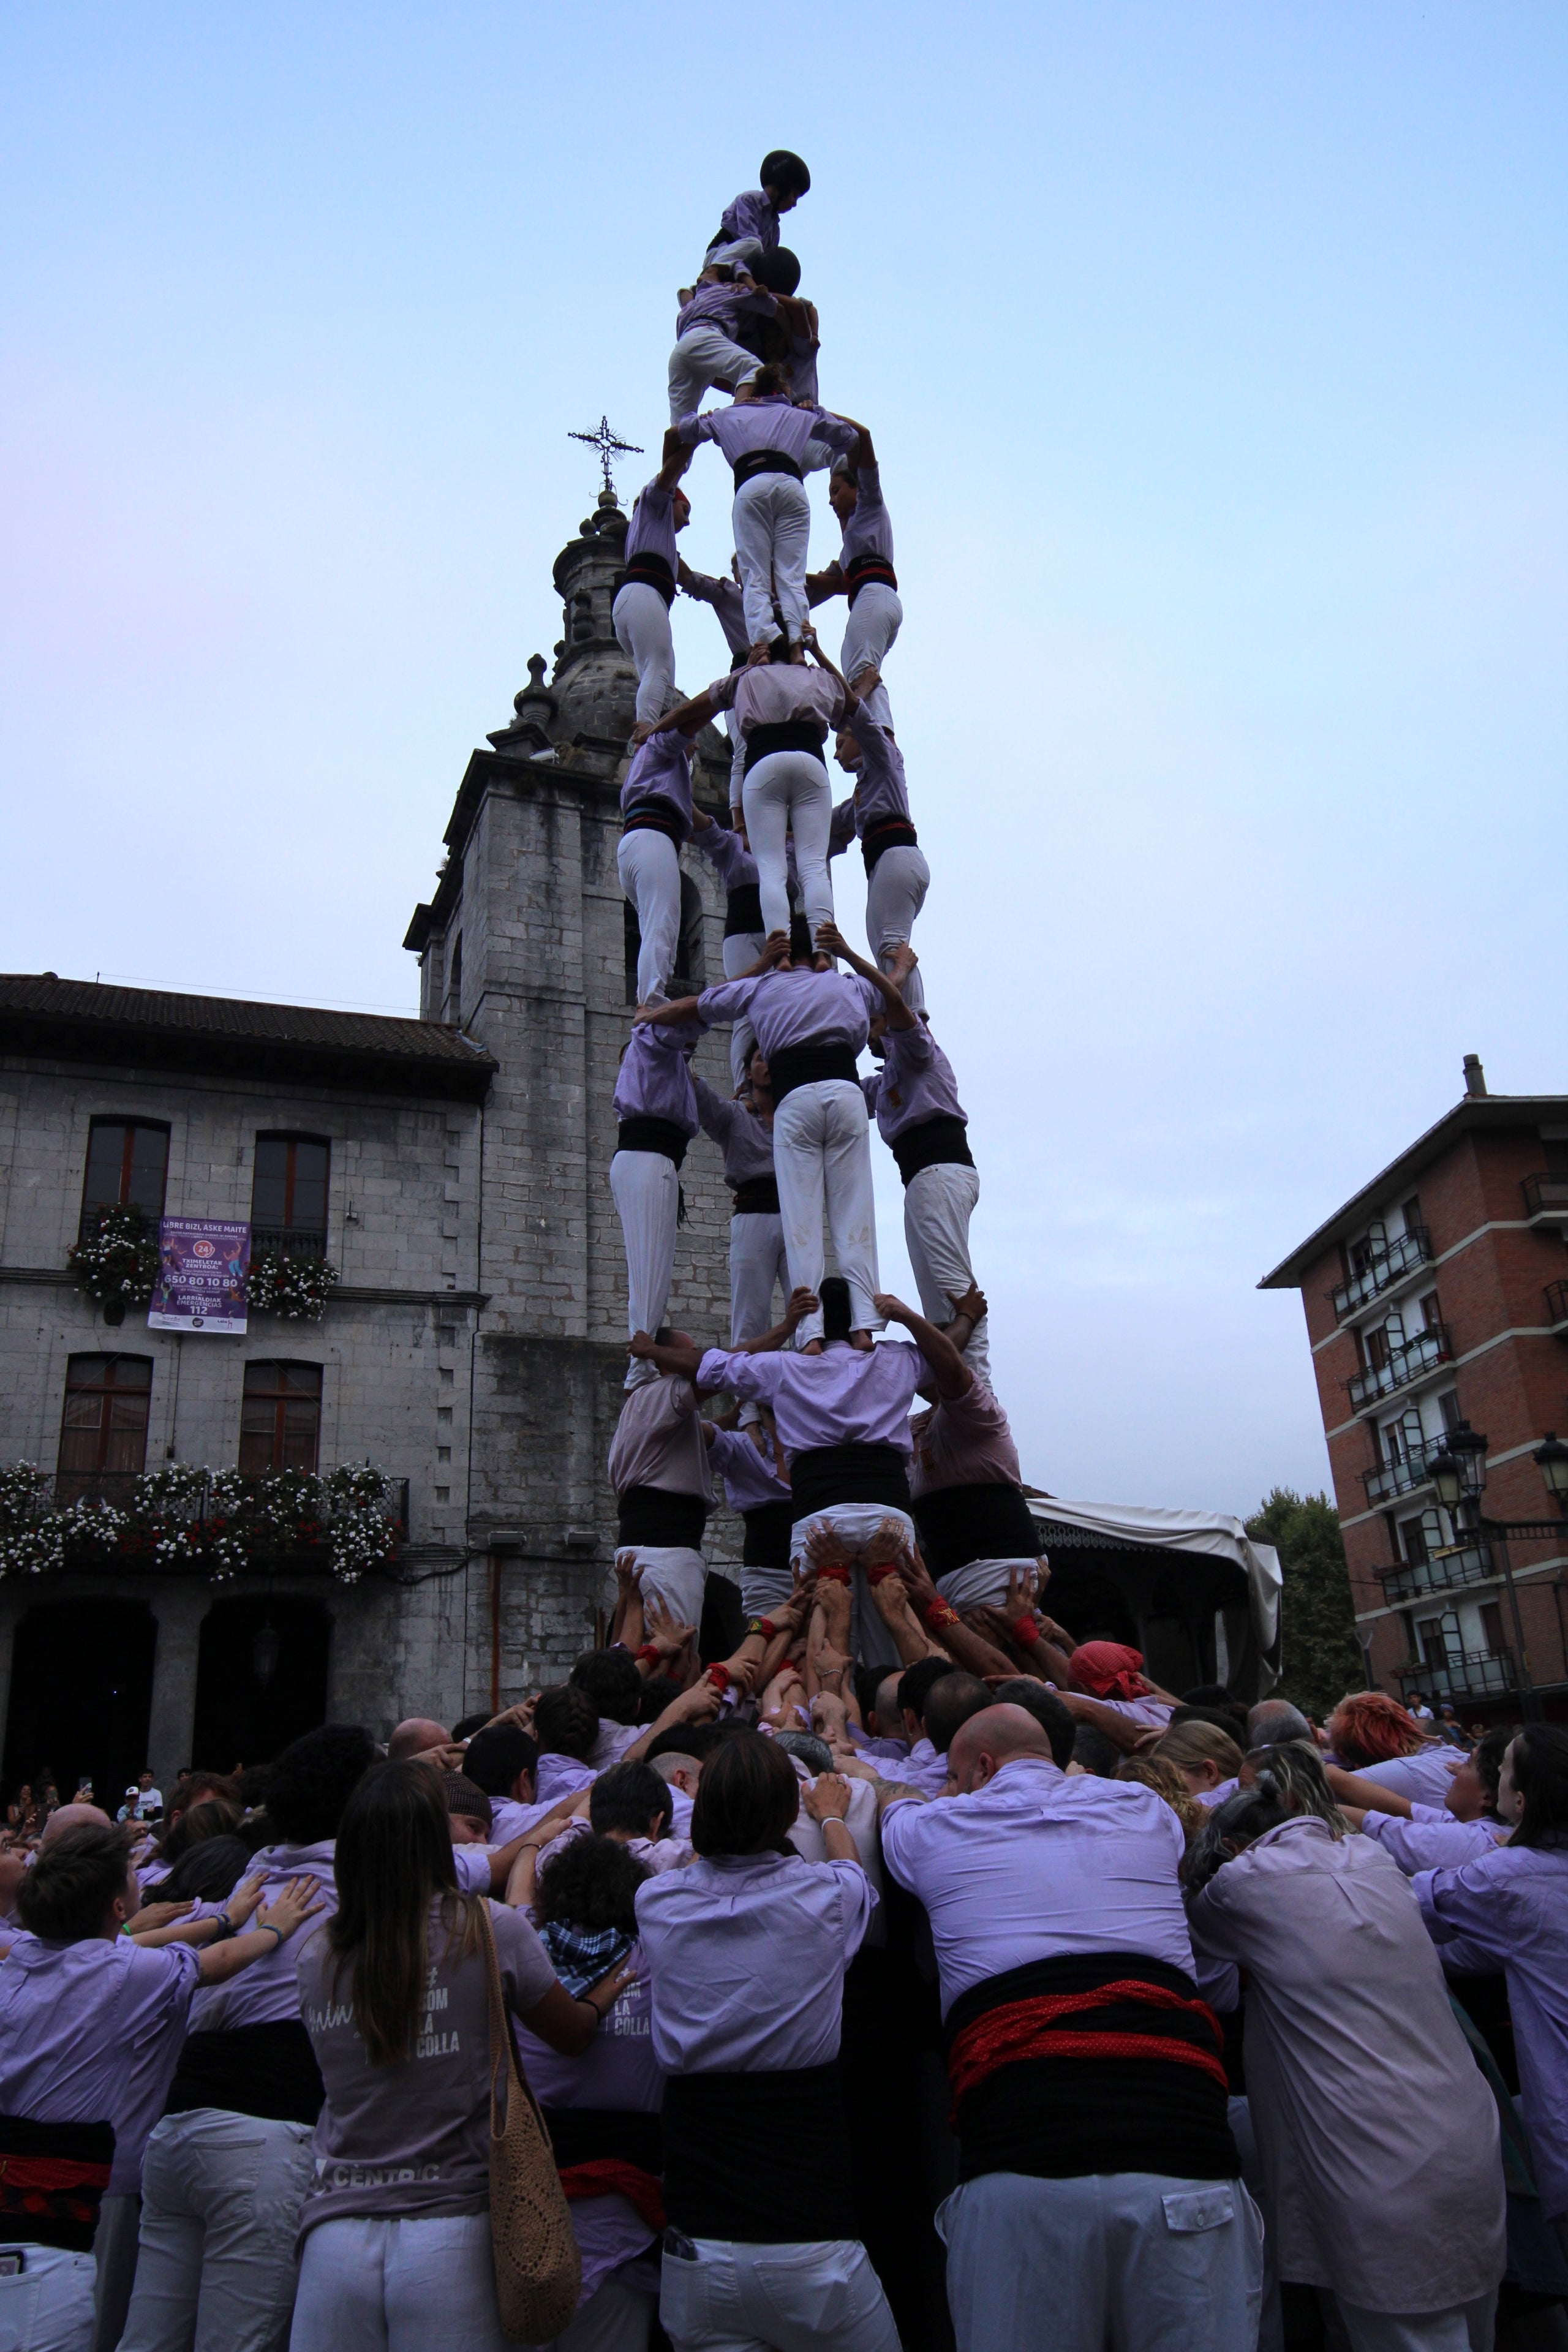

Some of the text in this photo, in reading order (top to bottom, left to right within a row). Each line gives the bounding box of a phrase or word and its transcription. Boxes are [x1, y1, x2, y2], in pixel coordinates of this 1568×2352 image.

[186, 1223, 202, 1231] BIZI,
[164, 1275, 186, 1284] 650
[189, 1276, 204, 1286] 80
[207, 1278, 220, 1286] 10
[190, 1305, 208, 1314] 112
[614, 1999, 631, 2016] LA
[614, 2017, 650, 2036] COLLA
[417, 2030, 459, 2058] COLLA
